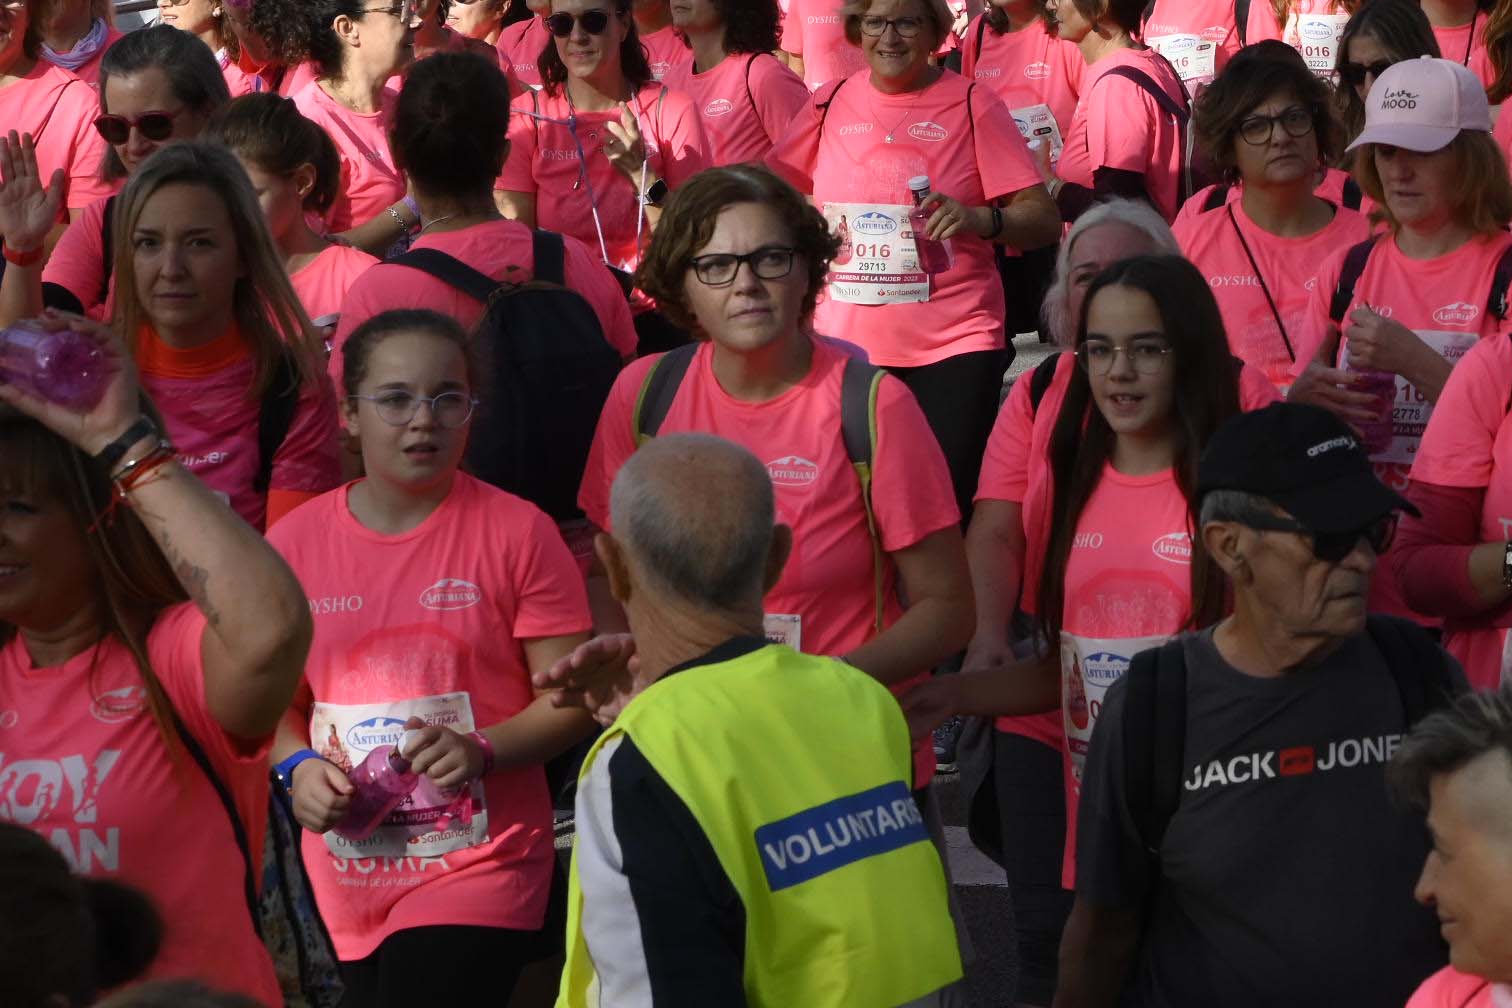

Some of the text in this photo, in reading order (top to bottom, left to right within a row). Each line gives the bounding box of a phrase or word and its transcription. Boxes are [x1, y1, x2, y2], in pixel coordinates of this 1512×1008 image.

[1305, 46, 1330, 57] 016
[1174, 56, 1189, 70] 16
[1308, 60, 1328, 68] 32223
[1381, 98, 1417, 110] MOOD
[839, 123, 874, 137] OYSHO
[856, 243, 891, 258] 016
[859, 262, 886, 271] 29713
[1392, 408, 1421, 420] 2778
[1072, 533, 1103, 549] SHO
[1157, 540, 1192, 557] ASTURI
[423, 588, 479, 606] ASTURIANA
[1083, 666, 1126, 679] ASTURIA
[352, 732, 402, 746] ASTURIA
[1184, 751, 1276, 792] JACK
[421, 826, 475, 844] Santander
